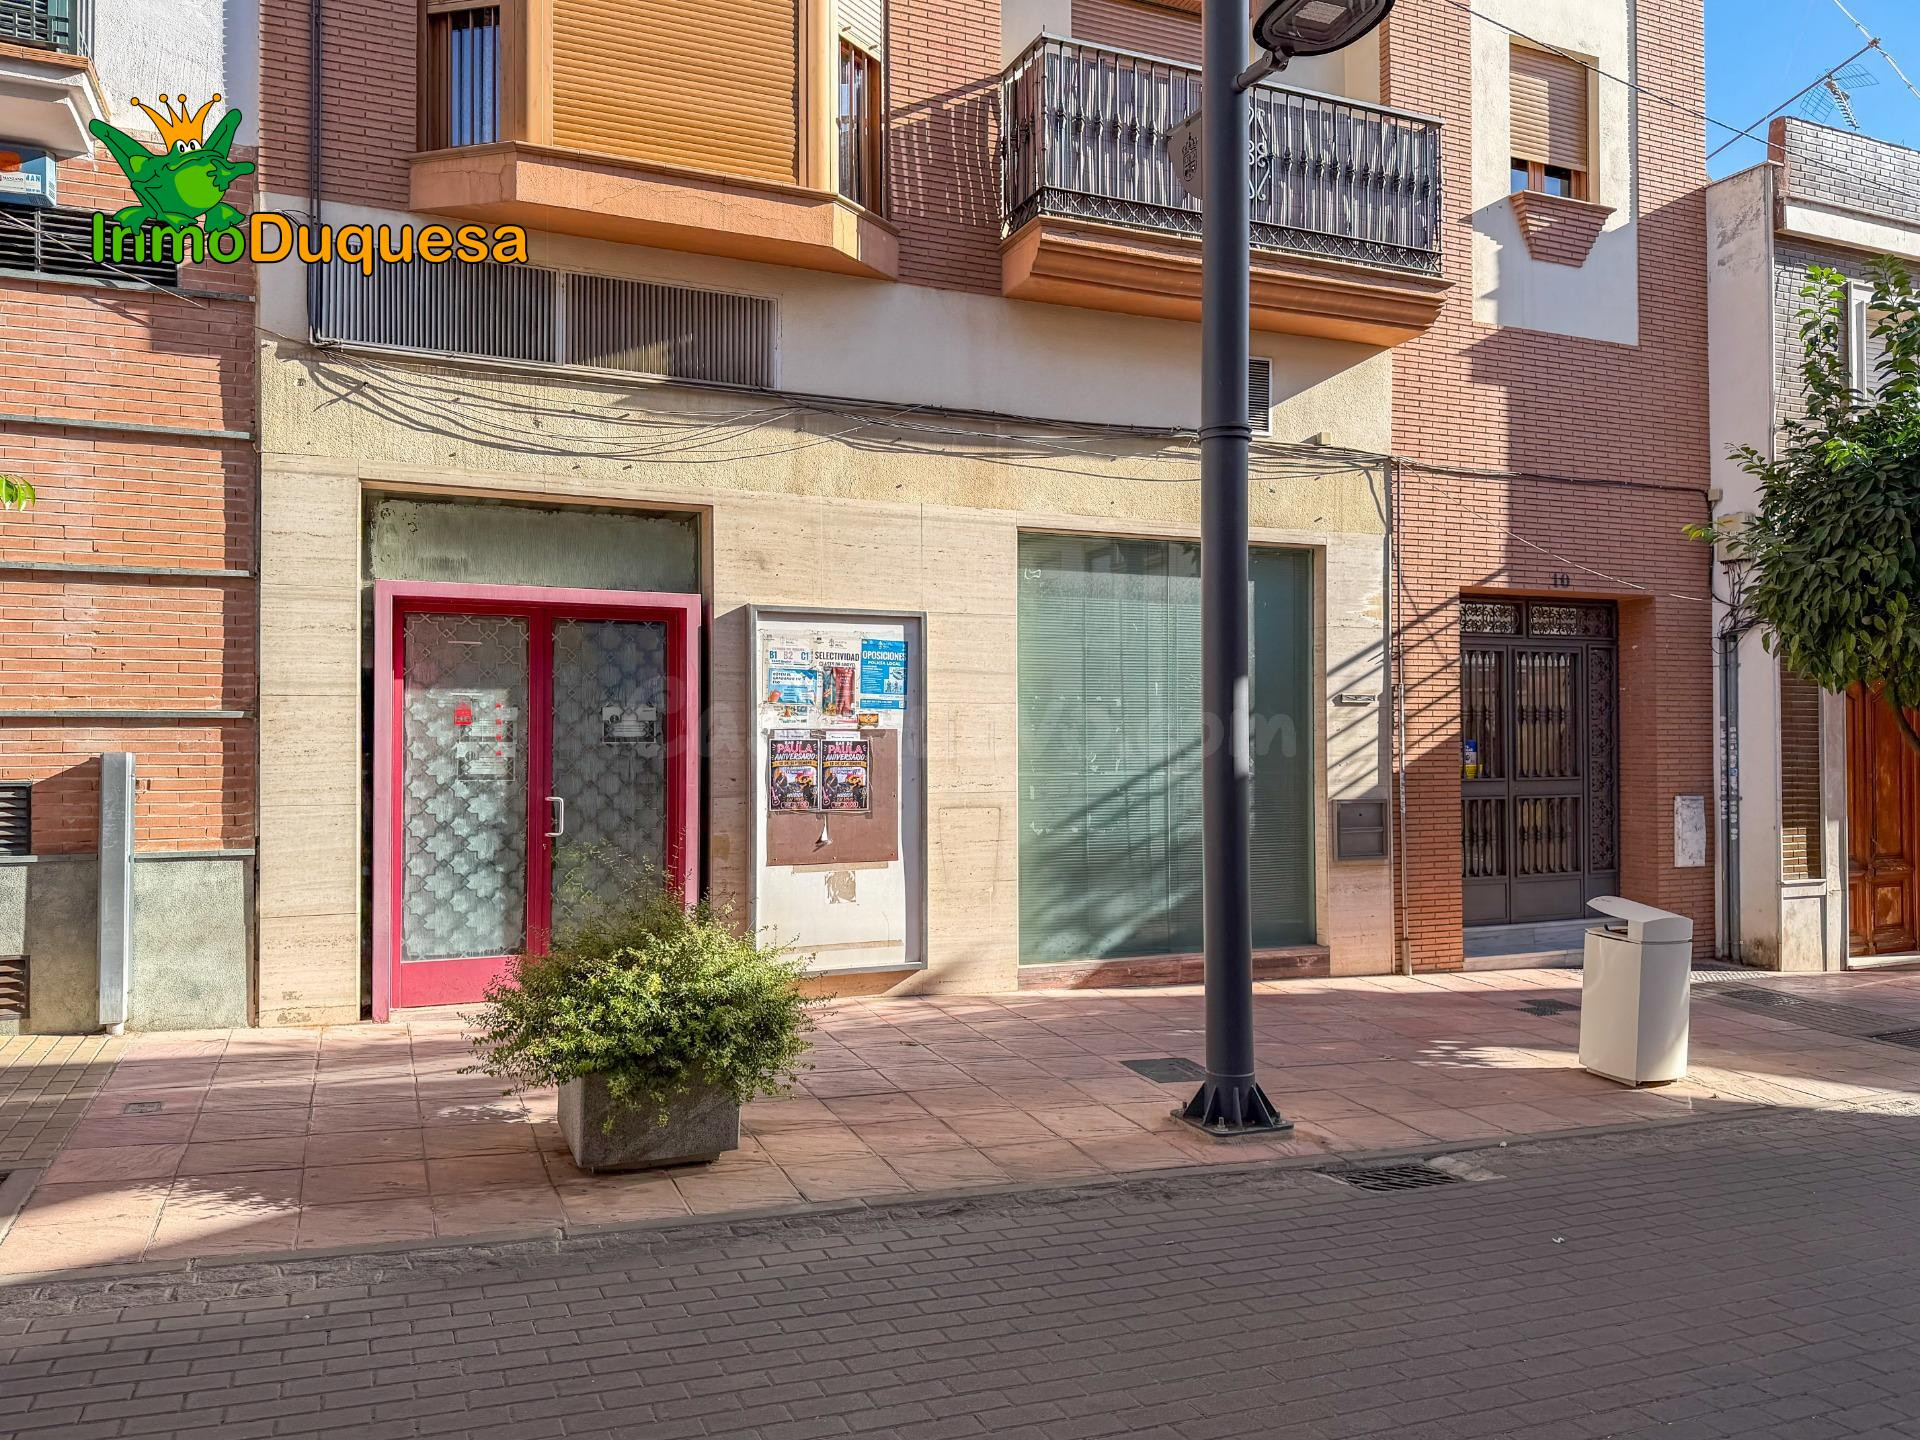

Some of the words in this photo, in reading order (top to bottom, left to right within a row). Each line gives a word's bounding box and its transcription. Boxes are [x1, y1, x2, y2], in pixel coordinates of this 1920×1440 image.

[1551, 572, 1570, 588] 10
[769, 650, 777, 659] B1
[784, 651, 793, 660] B2
[801, 651, 809, 660] C1
[814, 651, 860, 661] SELECTIVIDAD
[862, 650, 906, 661] OPOSICIONES
[776, 743, 813, 753] PAULA
[828, 744, 864, 754] PAULA
[775, 753, 816, 761] ANIVERSARIO
[826, 753, 866, 761] ANIVERSARIO
